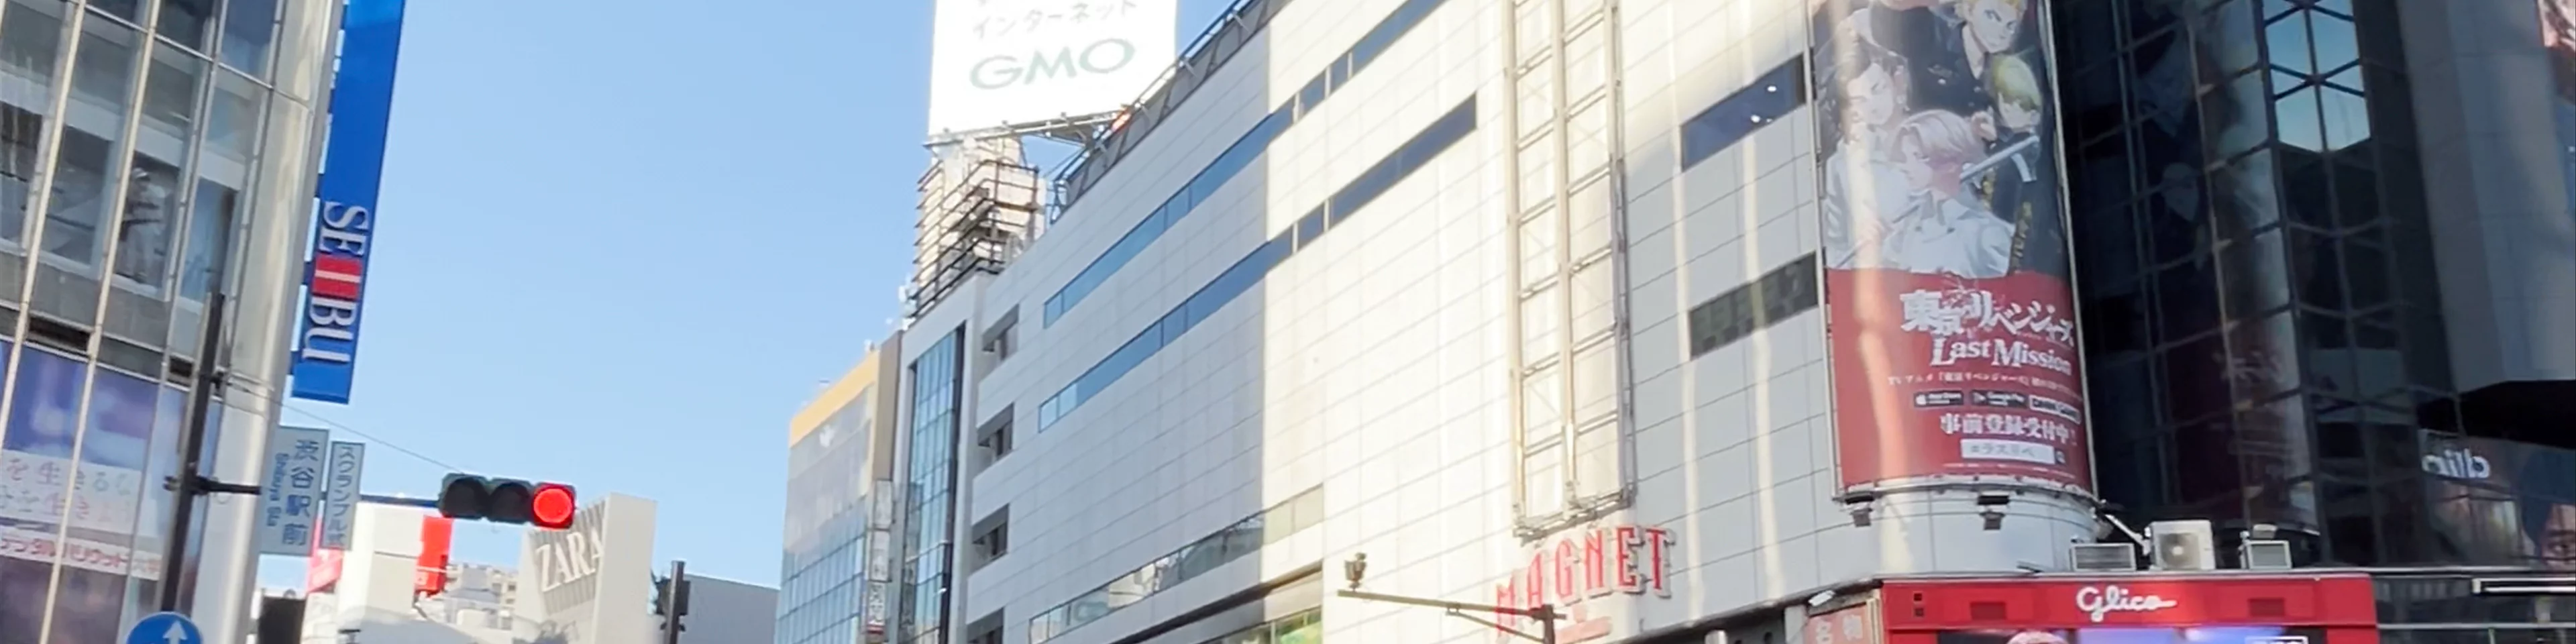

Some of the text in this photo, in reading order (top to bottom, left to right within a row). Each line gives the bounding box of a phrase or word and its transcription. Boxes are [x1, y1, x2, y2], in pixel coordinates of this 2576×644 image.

[969, 38, 1136, 90] GMO
[303, 201, 369, 363] SEIBU
[1930, 337, 1992, 366] Last
[1991, 339, 2072, 376] Mission
[282, 439, 319, 546] 渋谷駅前
[536, 527, 604, 592] ZARA
[1495, 527, 1667, 633] MAGNET
[2076, 585, 2178, 623] Glico
